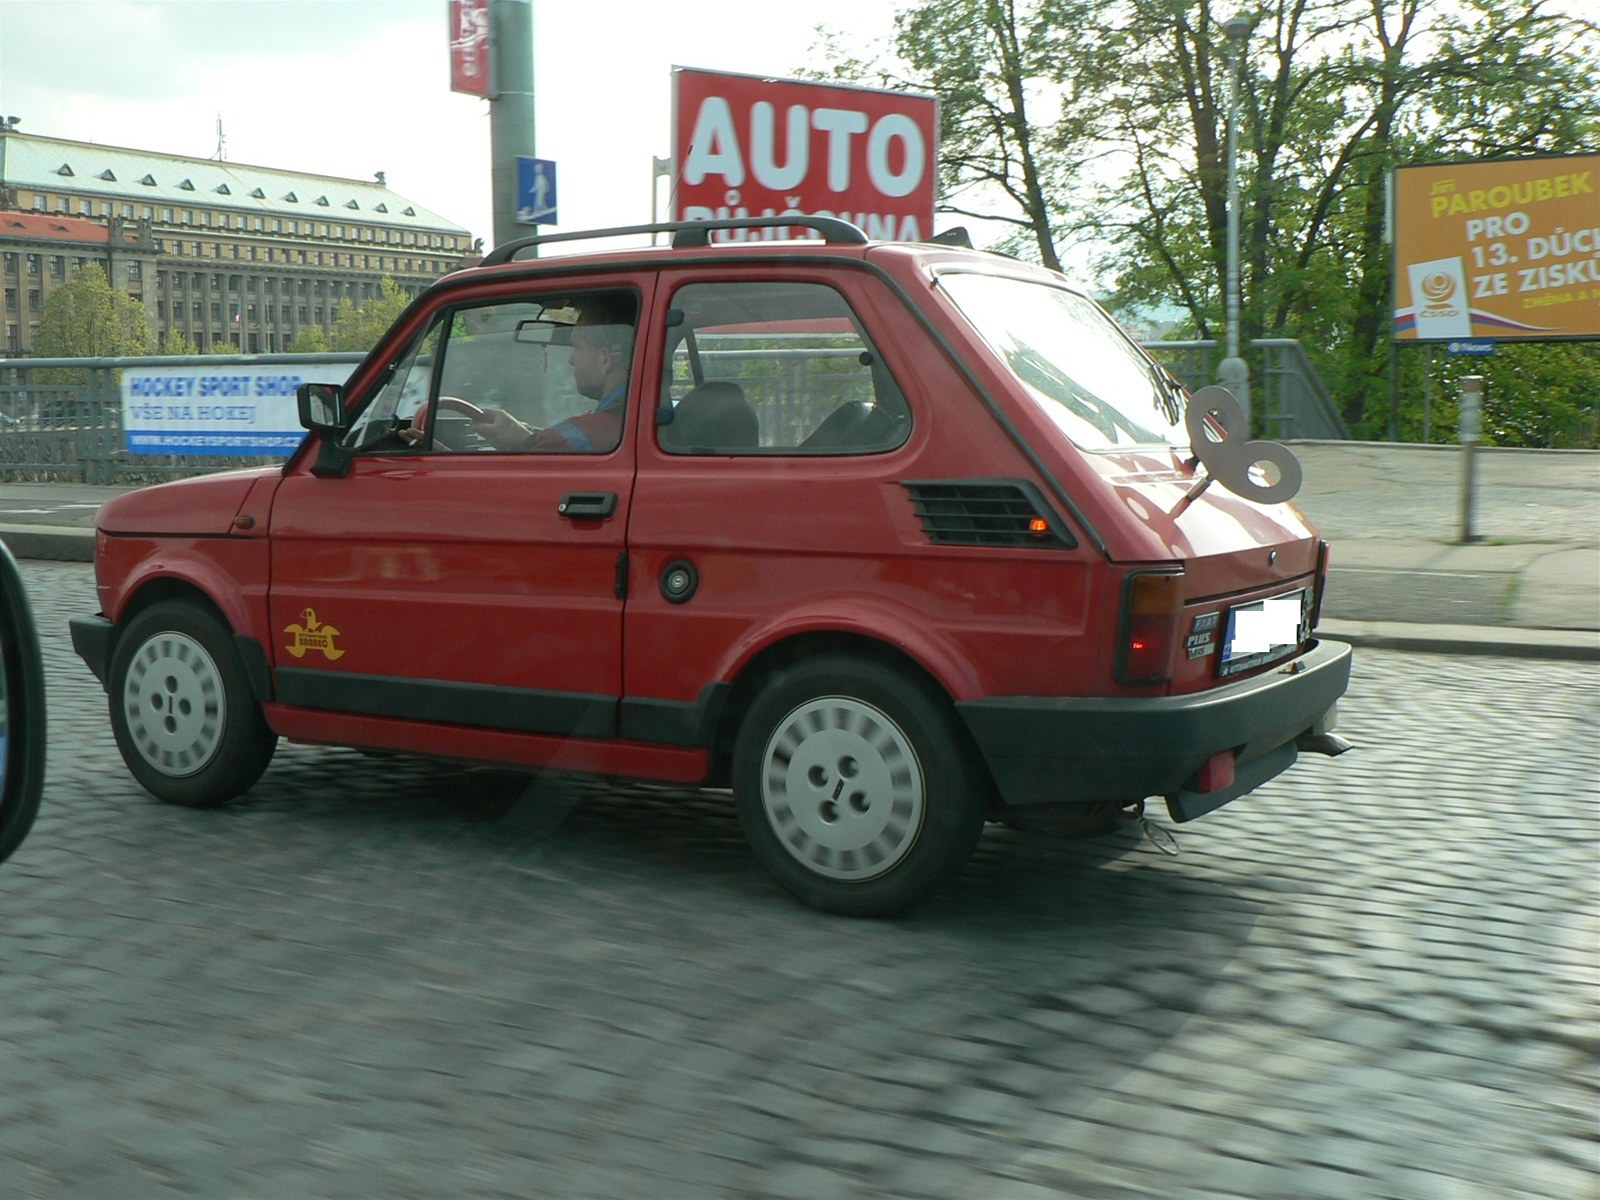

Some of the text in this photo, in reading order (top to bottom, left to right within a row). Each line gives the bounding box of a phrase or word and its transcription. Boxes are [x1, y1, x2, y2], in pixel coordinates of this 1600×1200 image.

[684, 96, 925, 197] AUTO
[1431, 171, 1594, 219] PAROUBEK
[1466, 211, 1530, 242] PRO
[1472, 242, 1518, 269] 13.
[1472, 272, 1509, 298] ZE
[130, 375, 303, 397] HOCKEY SPORT SHOP
[129, 402, 256, 424] VŠE NA HOKEJ
[1187, 632, 1211, 647] PLUS
